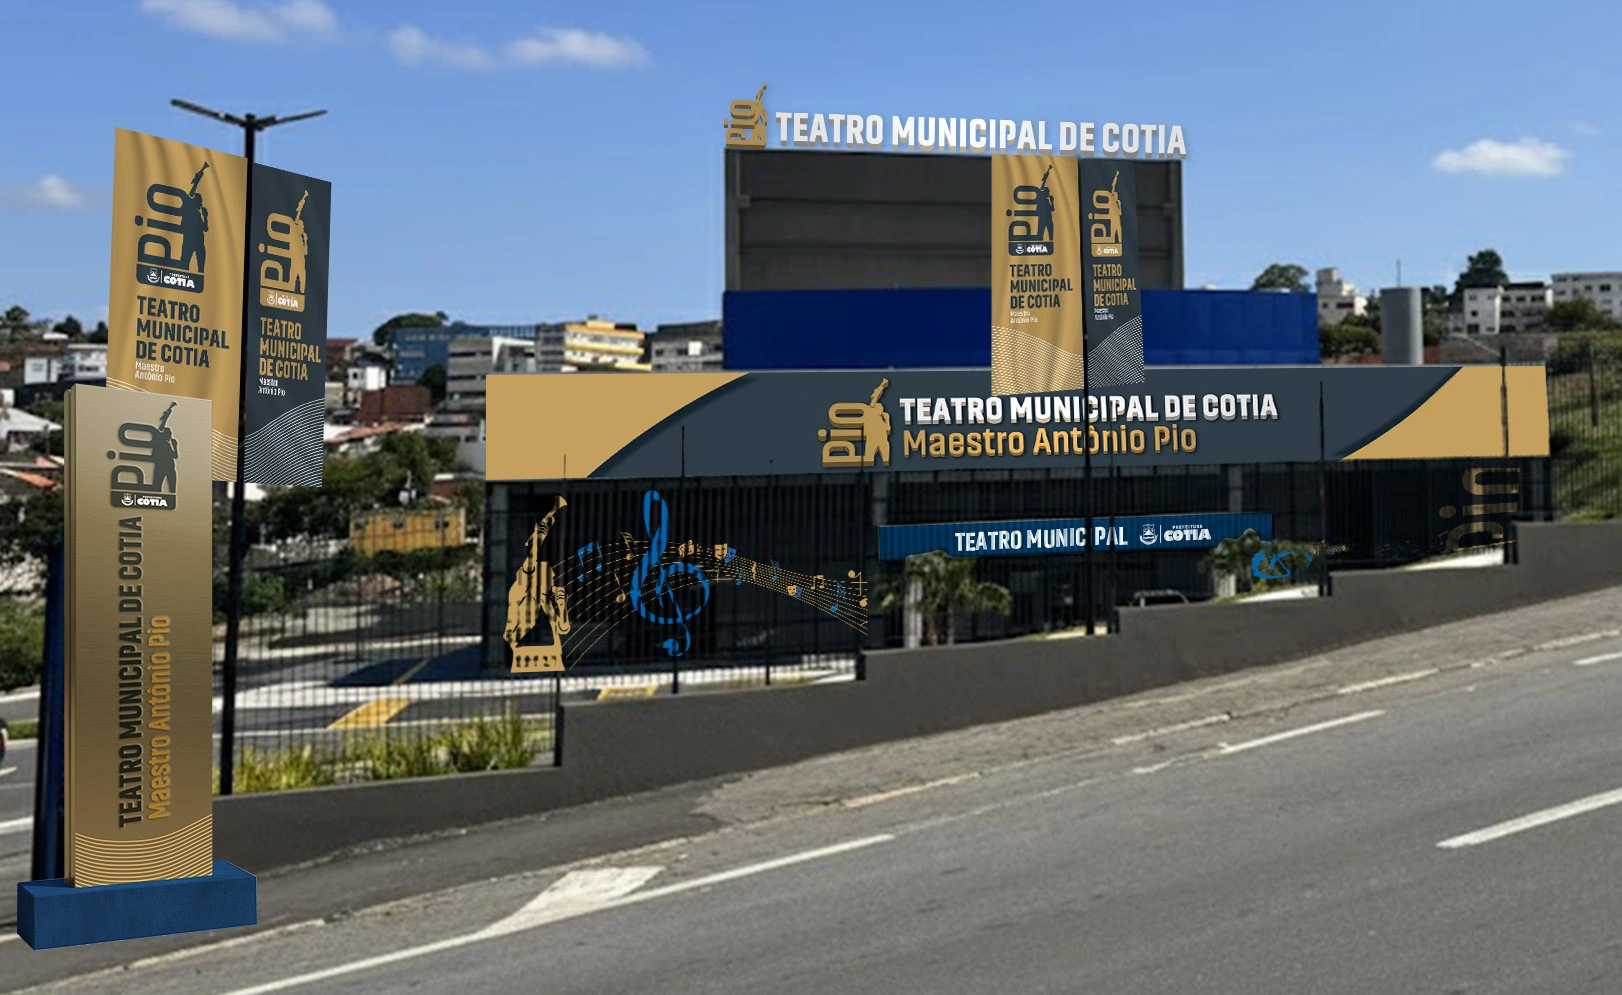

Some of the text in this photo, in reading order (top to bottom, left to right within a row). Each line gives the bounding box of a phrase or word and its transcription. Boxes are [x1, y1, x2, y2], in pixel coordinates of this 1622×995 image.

[776, 111, 1186, 159] TEATRO MUNICIPAL DE COTIA
[164, 275, 195, 288] COTIA
[1009, 263, 1052, 277] TEATRO
[1092, 263, 1122, 277] TEATRO
[1010, 278, 1073, 293] MUNICIPAL
[1093, 278, 1137, 292] MUNICIPAL
[137, 295, 200, 323] TEATRO
[1010, 294, 1060, 309] DE COTIA
[1094, 292, 1128, 307] DE COTIA
[136, 318, 229, 349] MUNICIPAL
[260, 317, 302, 340] TEATRO
[136, 340, 210, 368] DE COTIA
[260, 337, 321, 363] MUNICIPAL
[135, 361, 164, 373] Maestro
[259, 357, 308, 381] DE COTIA
[164, 374, 175, 384] Pio
[899, 393, 1278, 424] TEATRO MUNICIPAL DE COTIA
[903, 424, 1197, 458] Maestro Antônio Pio
[137, 497, 168, 507] COTIA
[954, 526, 1211, 552] TEATRO MUNICPAL COTIA
[118, 516, 142, 828] TEATRO MUNICIPAL DE COTIA
[146, 615, 170, 820] Maestro Antônio Pio
